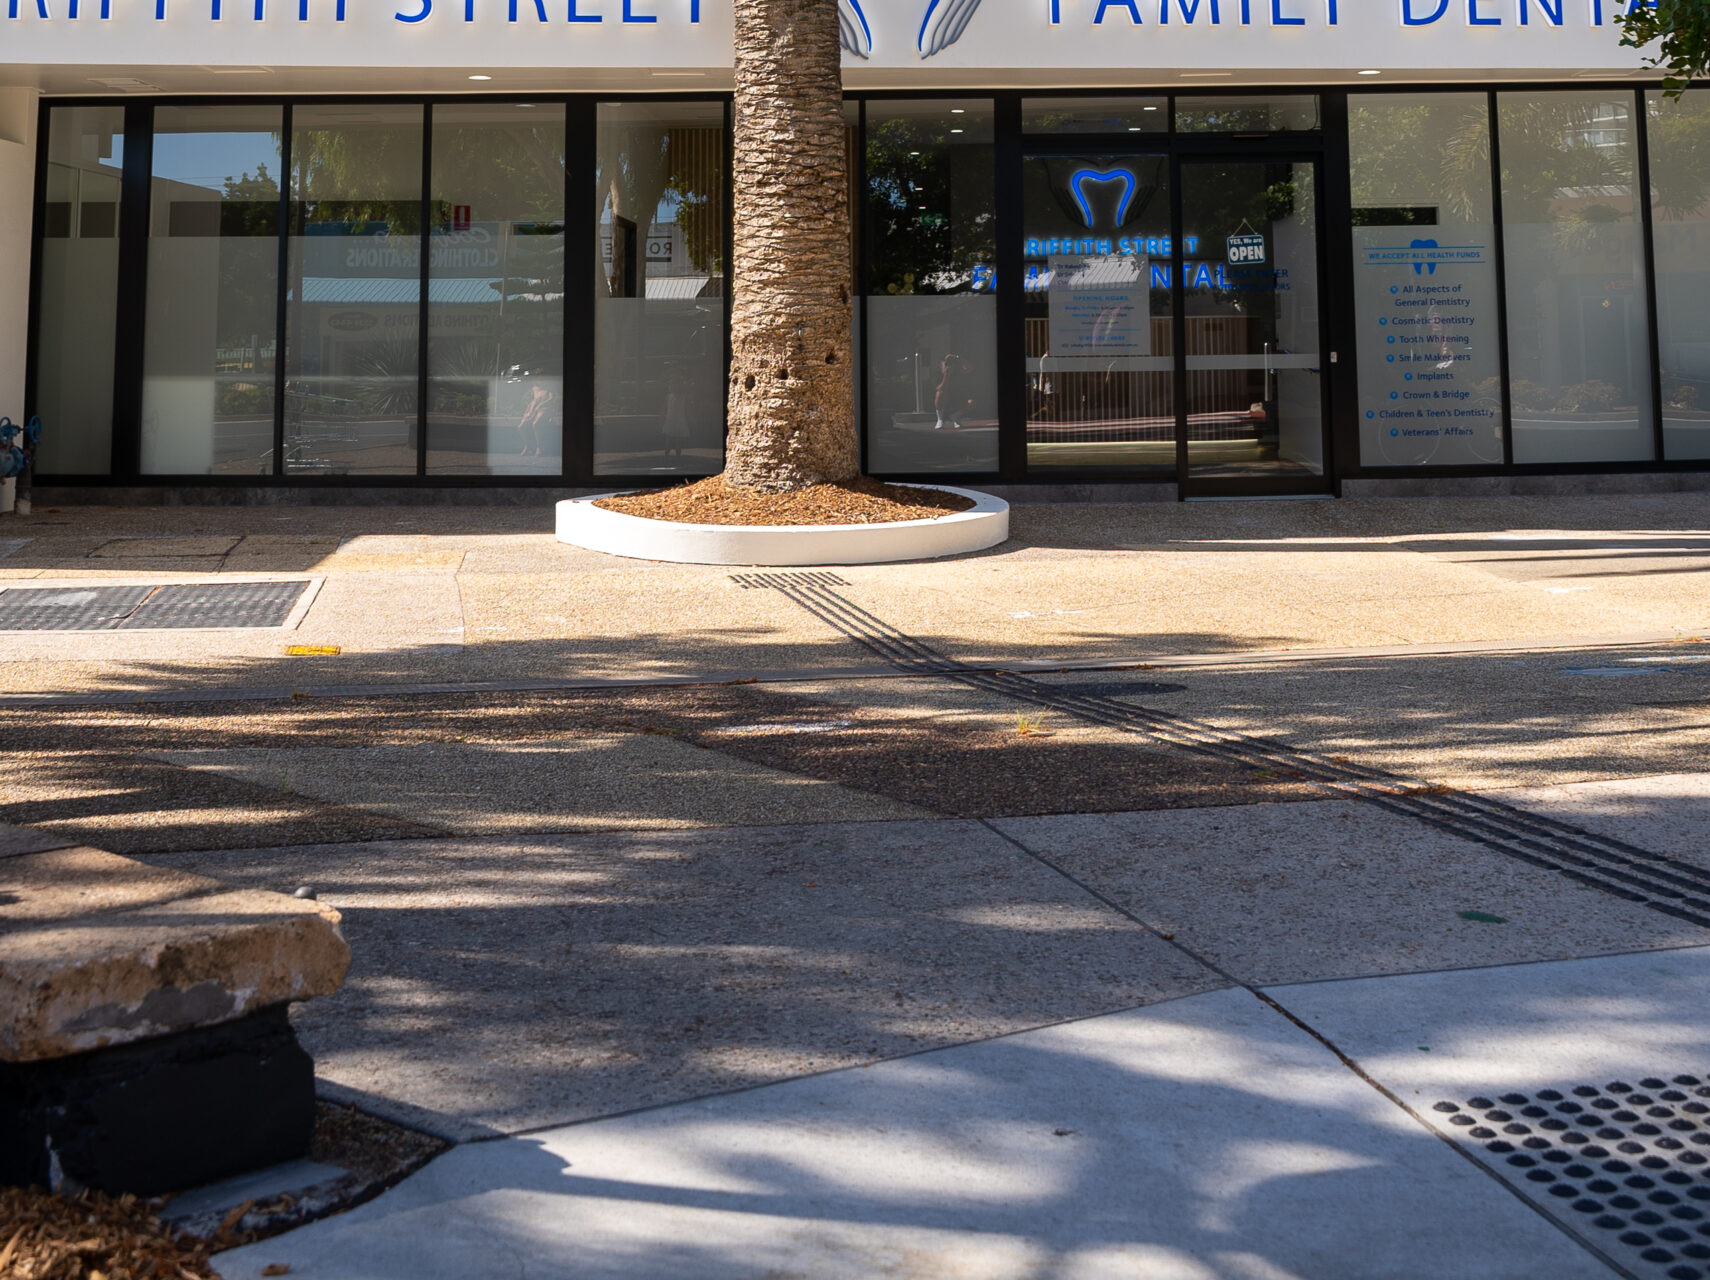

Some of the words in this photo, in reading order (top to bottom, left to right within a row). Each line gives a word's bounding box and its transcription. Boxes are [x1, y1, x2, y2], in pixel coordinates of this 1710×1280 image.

[1024, 238, 1112, 256] RIFFITH
[1119, 237, 1199, 256] STRET
[1230, 245, 1264, 262] OPEN
[1368, 252, 1379, 260] WE
[1382, 252, 1410, 260] ACCEPT
[1412, 251, 1425, 259] ALL
[1427, 251, 1455, 259] HEALTH
[1402, 284, 1414, 294] All
[1415, 285, 1450, 295] Aspects
[1451, 284, 1463, 293] of
[1394, 298, 1428, 307] General
[1429, 297, 1471, 308] Dentistry
[1391, 316, 1431, 326] Cosmetic
[1433, 316, 1475, 326] Dentistry
[1399, 335, 1424, 344] Tooth
[1426, 334, 1470, 345] Whitening
[1417, 371, 1455, 382] Implants
[1402, 391, 1431, 400] Crown
[1433, 390, 1440, 399] &
[1441, 389, 1470, 400] Bridge
[1379, 409, 1417, 419] Children
[1417, 409, 1424, 418] &
[1425, 409, 1452, 418] Teen's
[1453, 408, 1495, 419] Dentistry
[1401, 427, 1442, 438] Veterans'
[1444, 426, 1474, 437] Affairs
